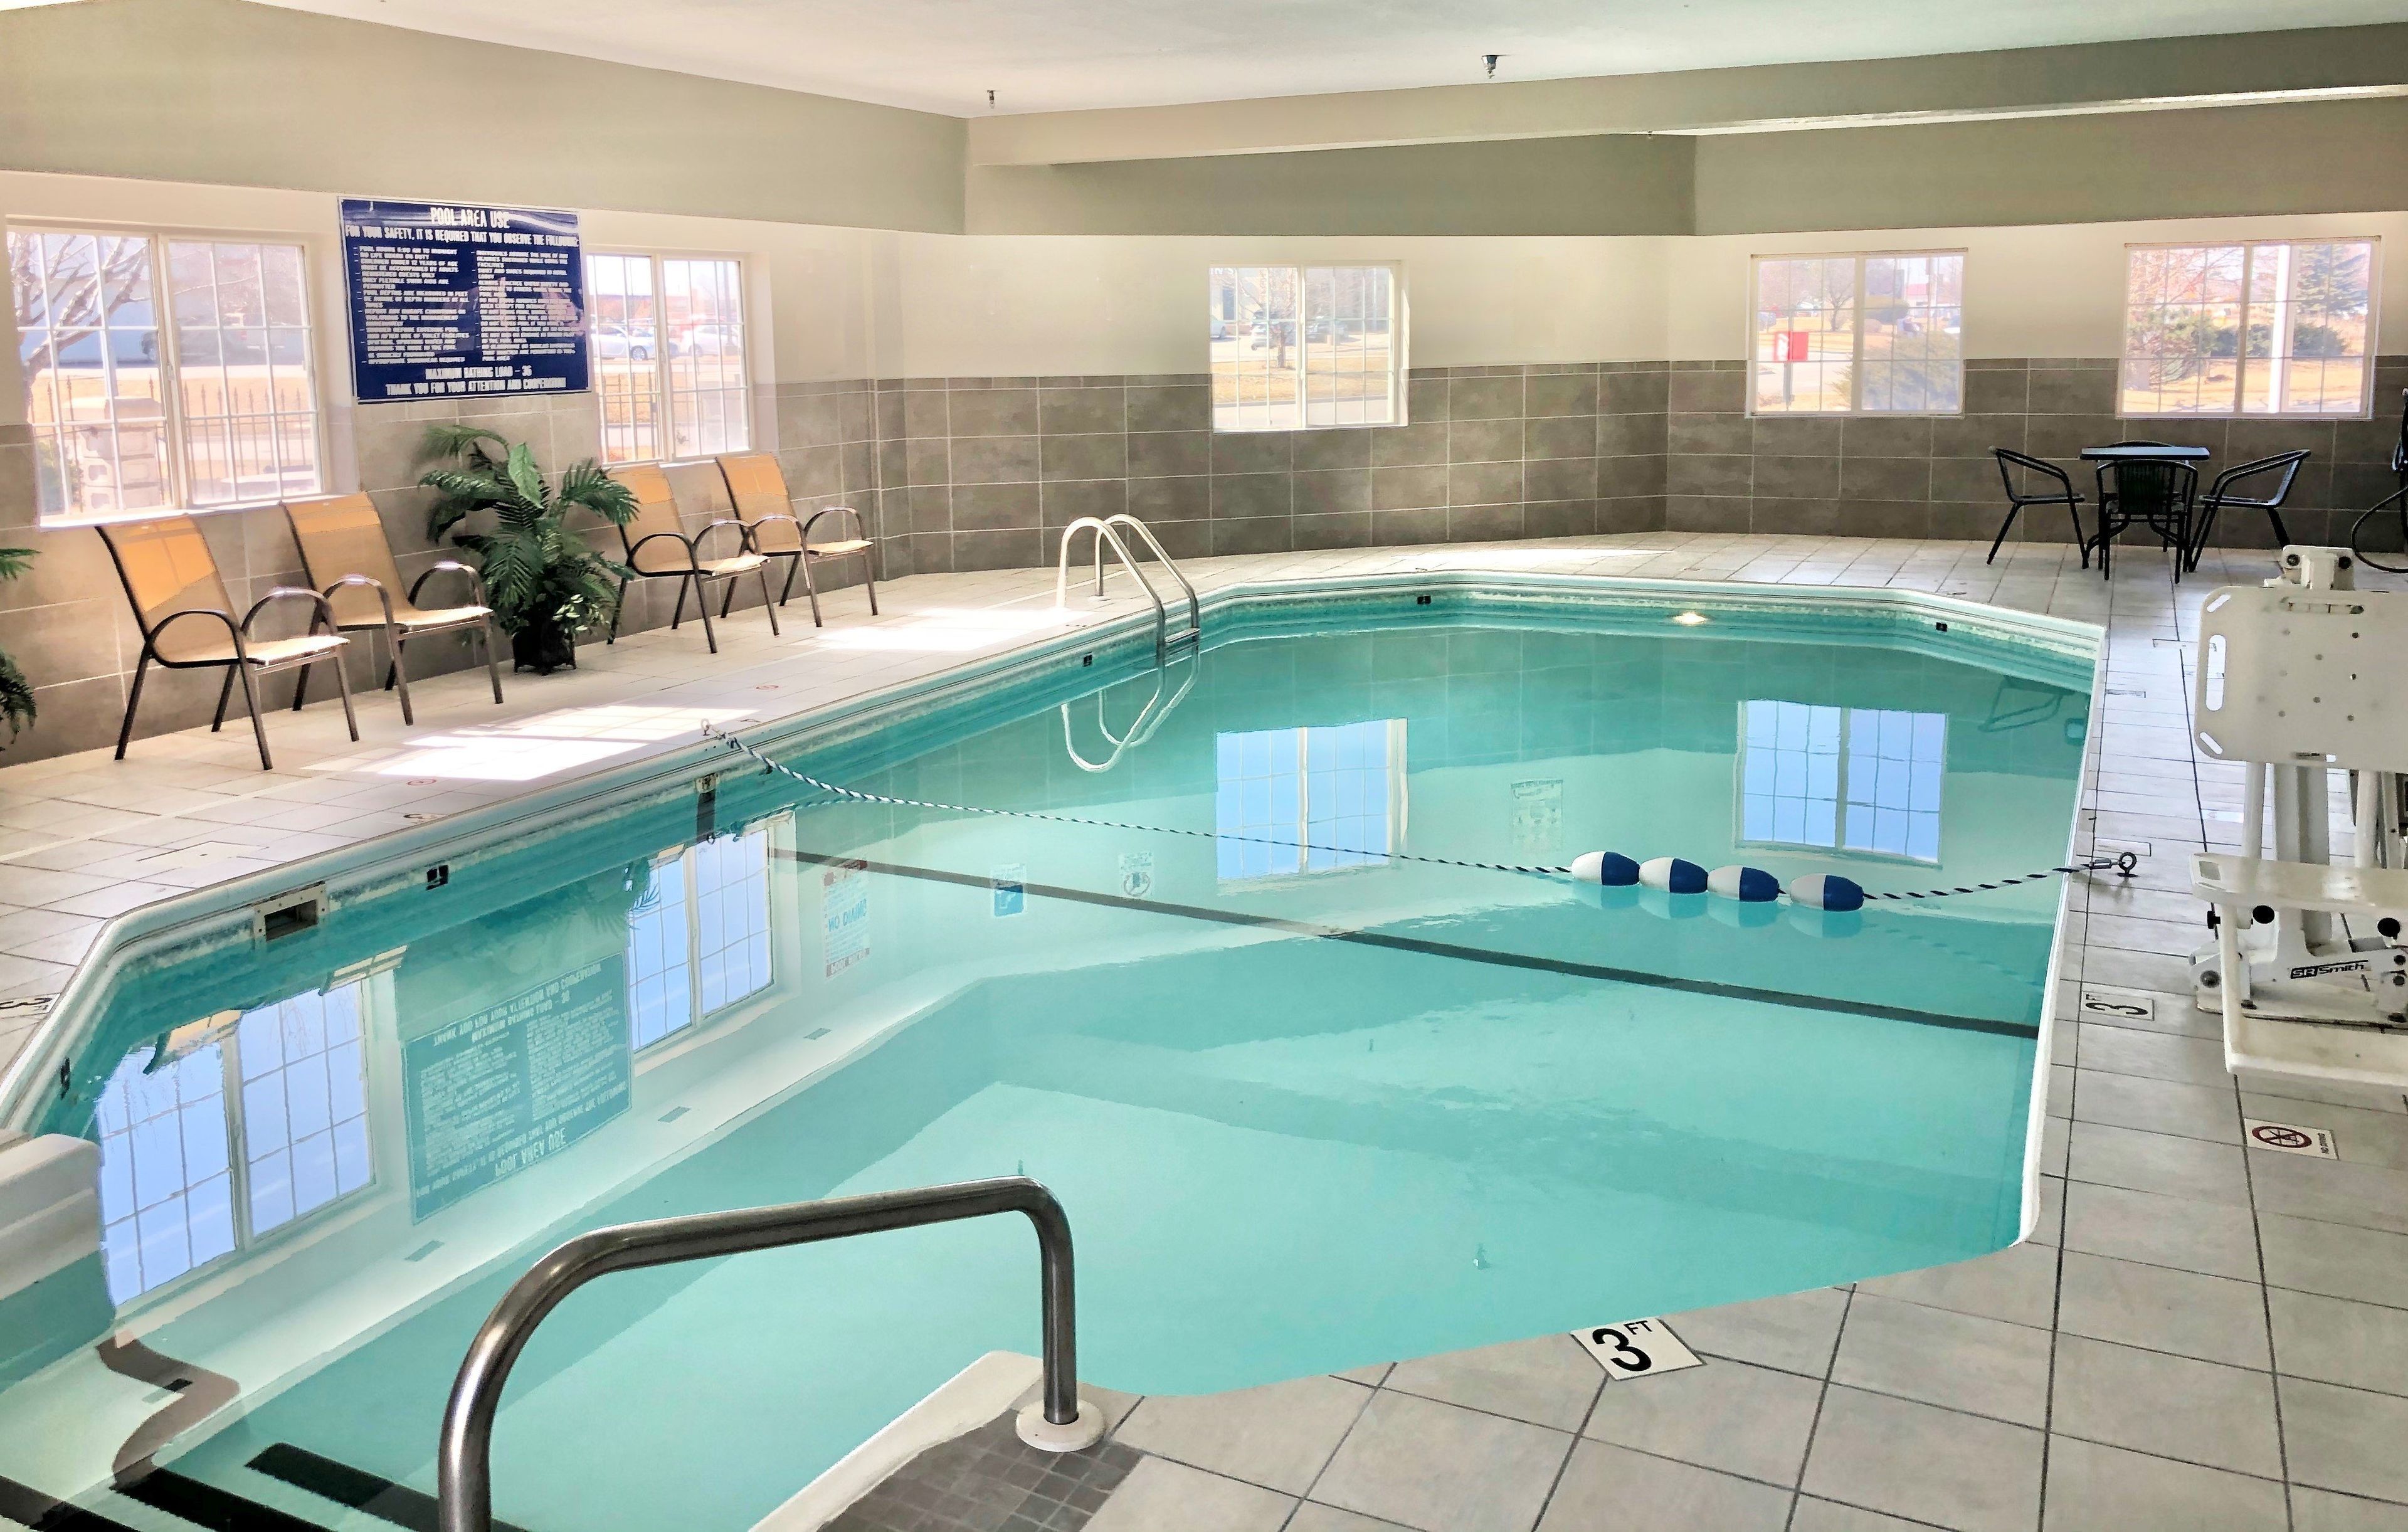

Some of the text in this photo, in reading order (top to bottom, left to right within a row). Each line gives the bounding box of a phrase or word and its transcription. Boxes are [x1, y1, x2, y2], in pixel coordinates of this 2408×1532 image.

[430, 207, 510, 228] POOL AREA USE
[416, 228, 423, 240] IT
[425, 229, 433, 241] IS
[470, 231, 488, 243] THAT
[2292, 963, 2364, 978] SR Smith
[2085, 1002, 2148, 1015] 3
[1592, 1319, 1653, 1372] 3 FT
